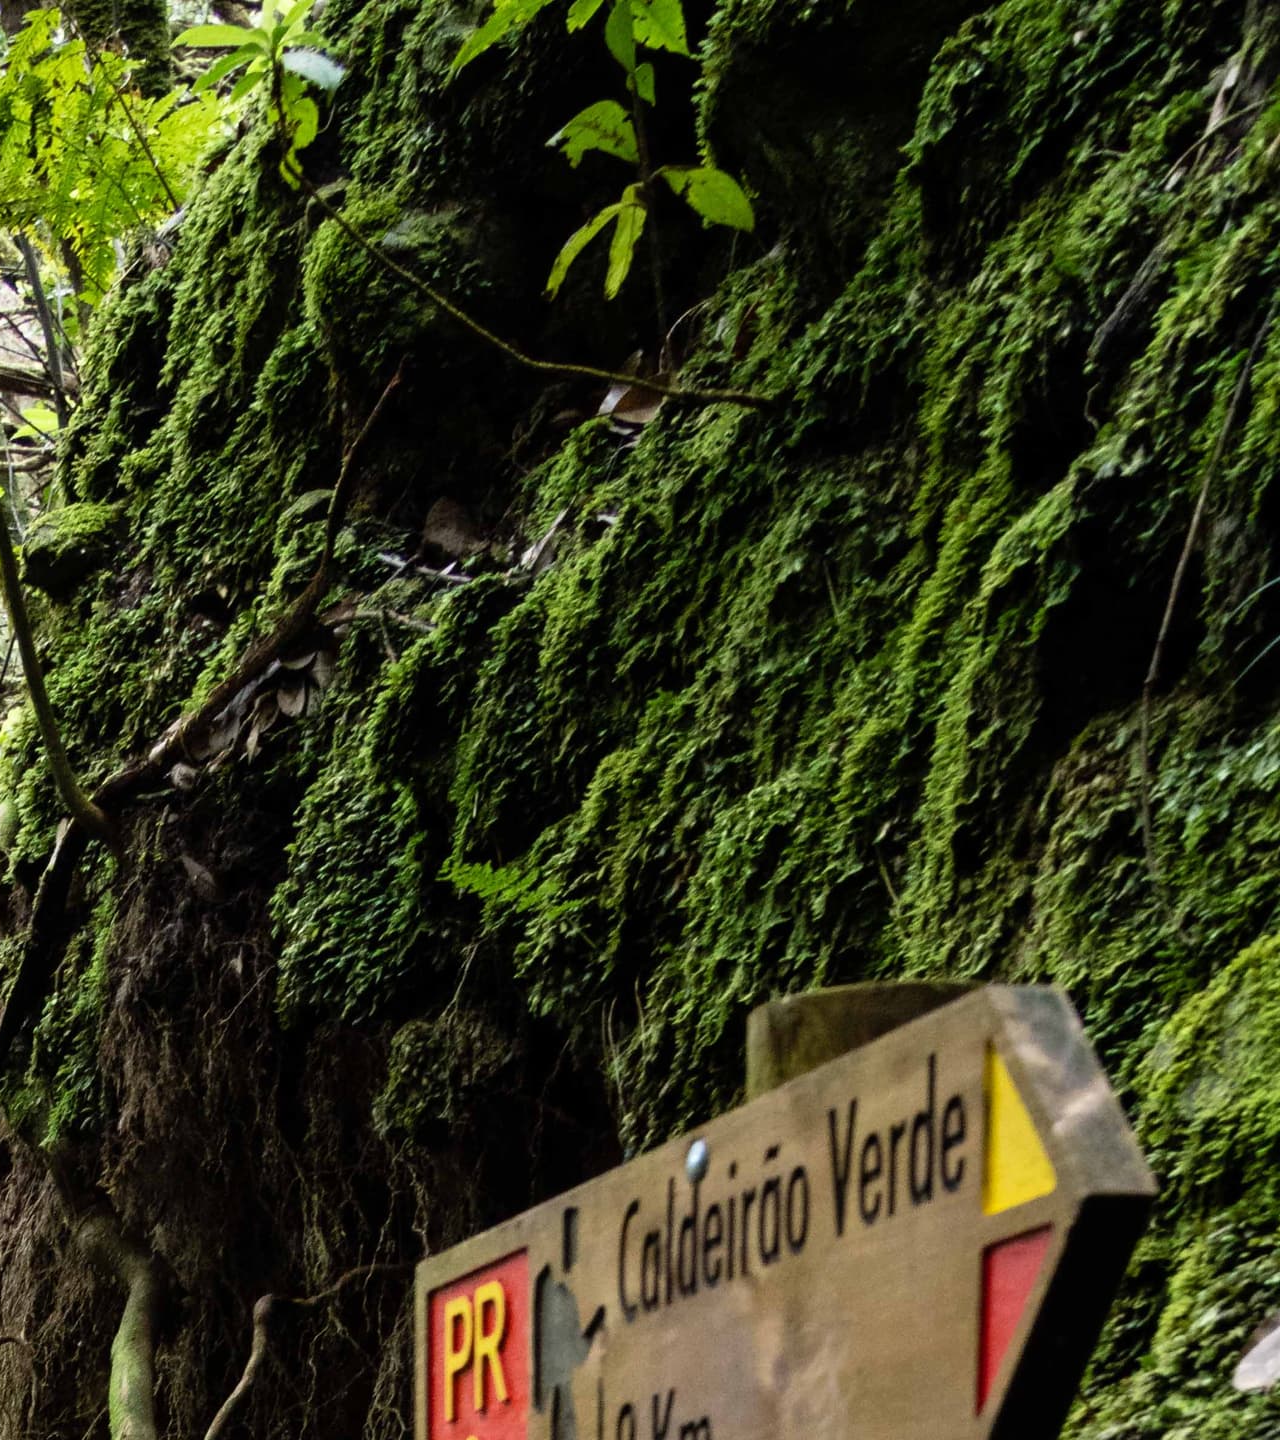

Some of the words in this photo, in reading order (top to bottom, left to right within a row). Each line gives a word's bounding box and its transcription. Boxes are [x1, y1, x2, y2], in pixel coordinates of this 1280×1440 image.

[616, 1144, 811, 1323] Caldeirão
[829, 1053, 967, 1238] Verde
[443, 1281, 507, 1422] PR
